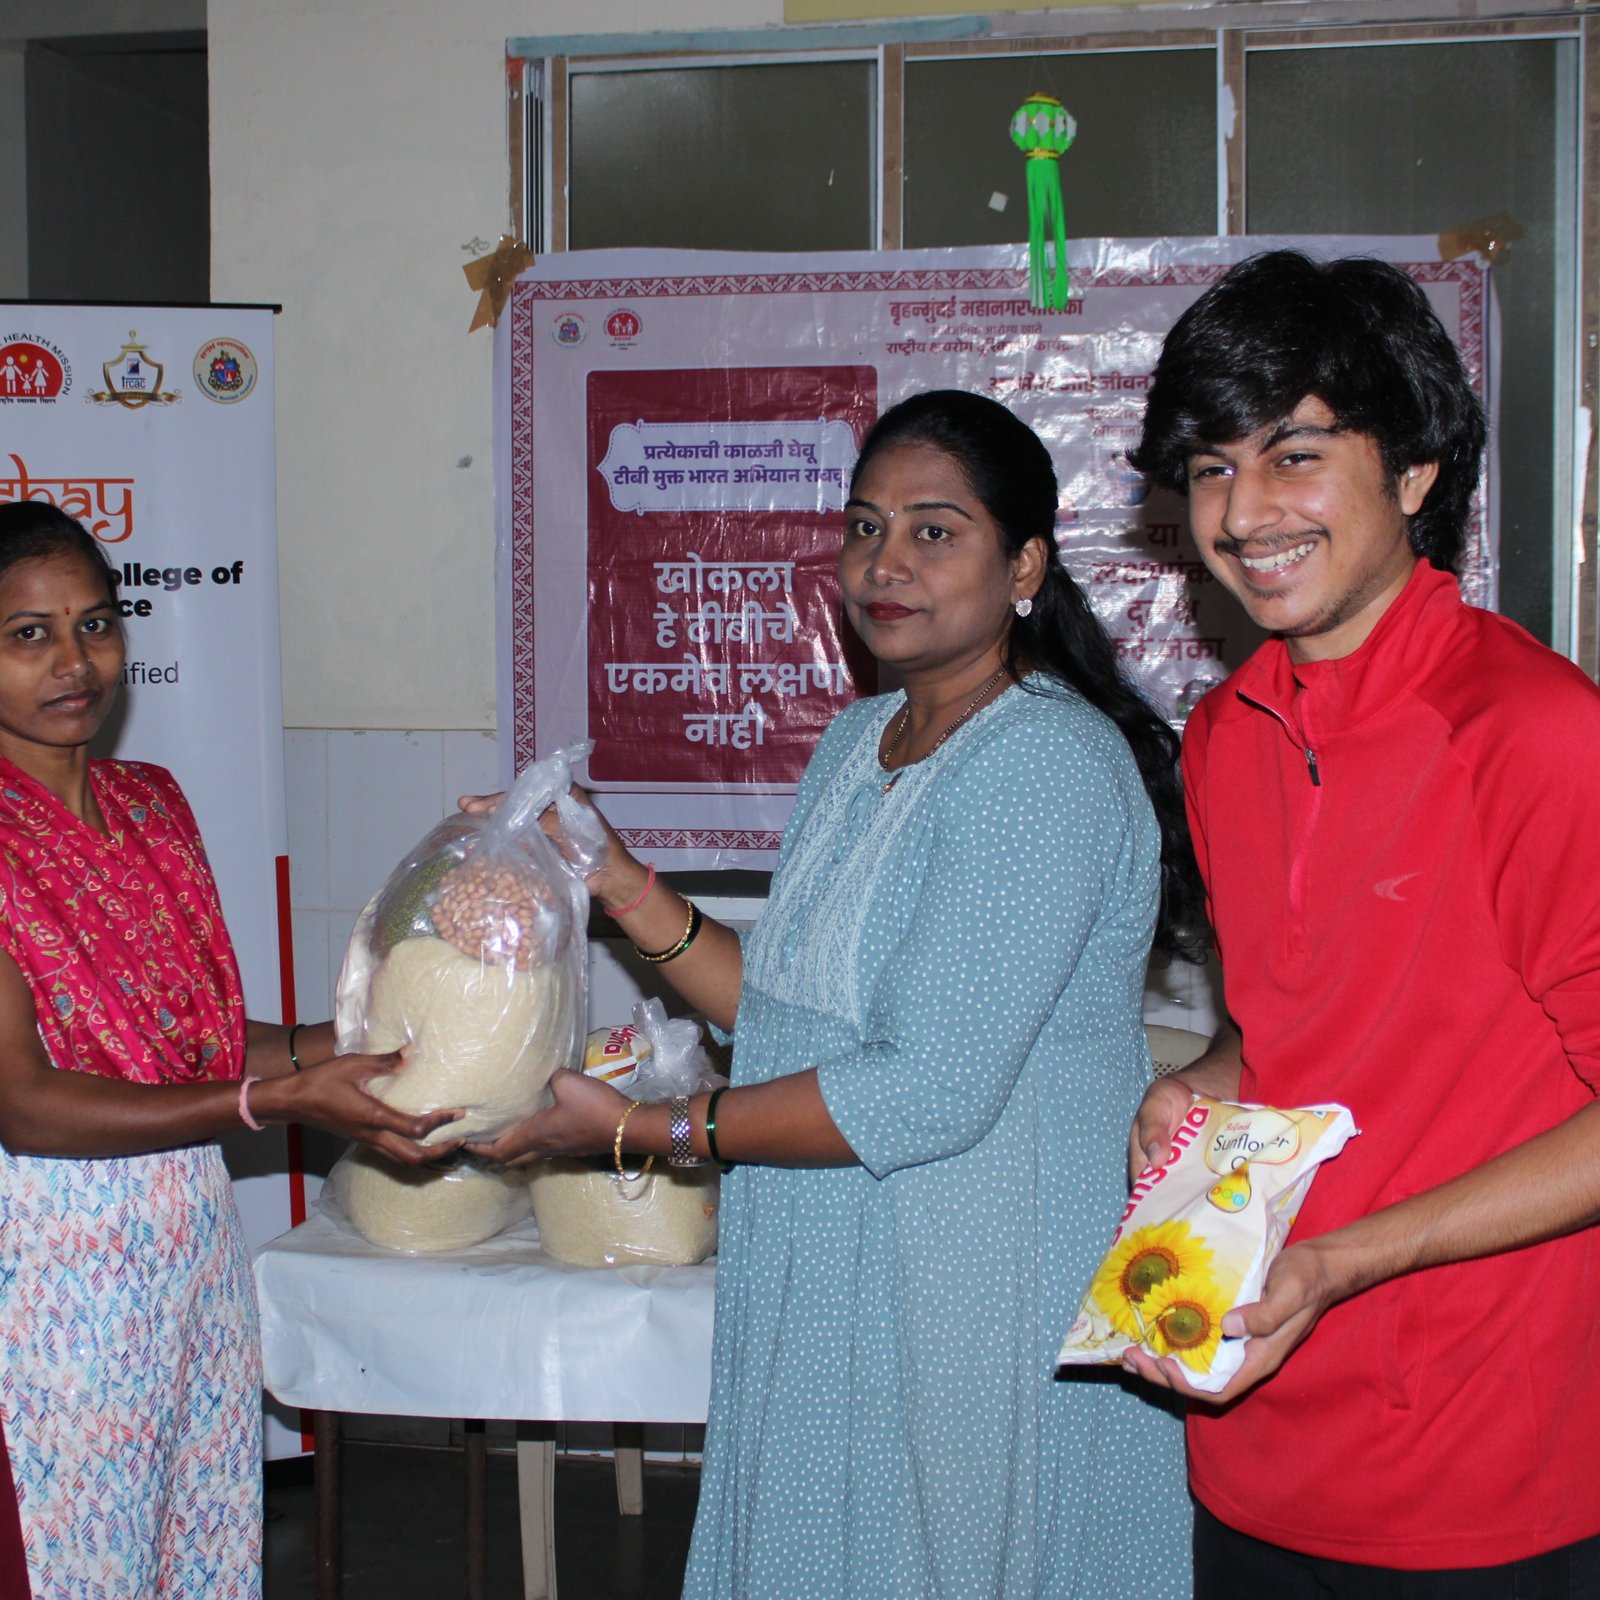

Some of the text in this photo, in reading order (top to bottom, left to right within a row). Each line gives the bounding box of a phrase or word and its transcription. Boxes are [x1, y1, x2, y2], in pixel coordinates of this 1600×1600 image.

[886, 338, 926, 357] राष्ट्रीय
[3, 332, 73, 396] HEALTH MISSION
[643, 439, 818, 464] प्रत्येकाची काळजी घेवू
[613, 465, 649, 485] टीबी
[653, 468, 685, 490] मुक्त
[688, 468, 729, 484] भारत
[733, 464, 800, 484] अभियान
[1146, 524, 1181, 547] या
[211, 560, 244, 585] of
[653, 552, 796, 593] खोकला
[653, 600, 798, 649] हे टीबीचे
[604, 653, 848, 697] एकमेव लक्षण
[683, 702, 767, 750] नाही
[1213, 1133, 1290, 1153] Sunflor
